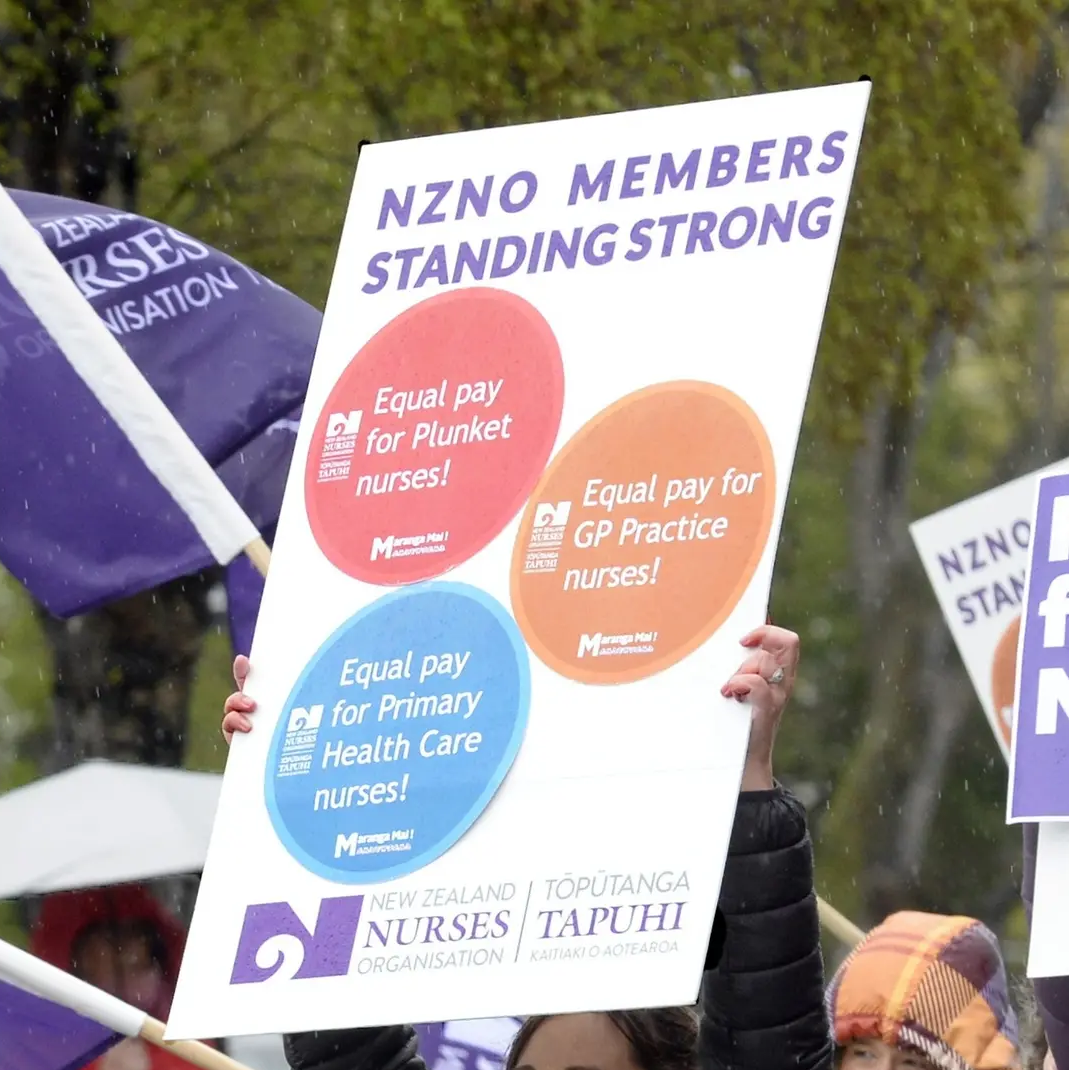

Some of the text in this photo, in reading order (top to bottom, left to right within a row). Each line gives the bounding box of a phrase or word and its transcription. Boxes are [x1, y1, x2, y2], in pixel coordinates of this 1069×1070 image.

[377, 130, 848, 230] NZNO MEMBERS
[61, 226, 210, 299] RSES
[361, 196, 835, 295] STANDING STRONG
[103, 265, 239, 335] NISATION
[373, 379, 504, 419] Equal pay
[322, 440, 356, 452] NURSES
[366, 413, 513, 455] for Plunket
[355, 458, 452, 497] nurses!
[582, 468, 762, 512] Equal pay for
[530, 532, 564, 542] NURSES
[574, 513, 728, 549] GP Practice
[937, 519, 1031, 581] NZNO
[563, 556, 661, 591] nurses!
[339, 650, 471, 690] Equal pay
[331, 691, 483, 727] for Primary
[284, 734, 317, 747] NURSES
[322, 729, 482, 769] Health Care
[314, 773, 410, 811] nurses!
[369, 882, 516, 912] NEW ZEALAND
[544, 869, 691, 901] TŌPŪTANGA
[362, 909, 511, 949] NURSES
[537, 901, 688, 940] TAPUHI
[357, 946, 504, 976] ORGANISATION
[530, 940, 679, 963] KAITIAKI O AOTEAROA
